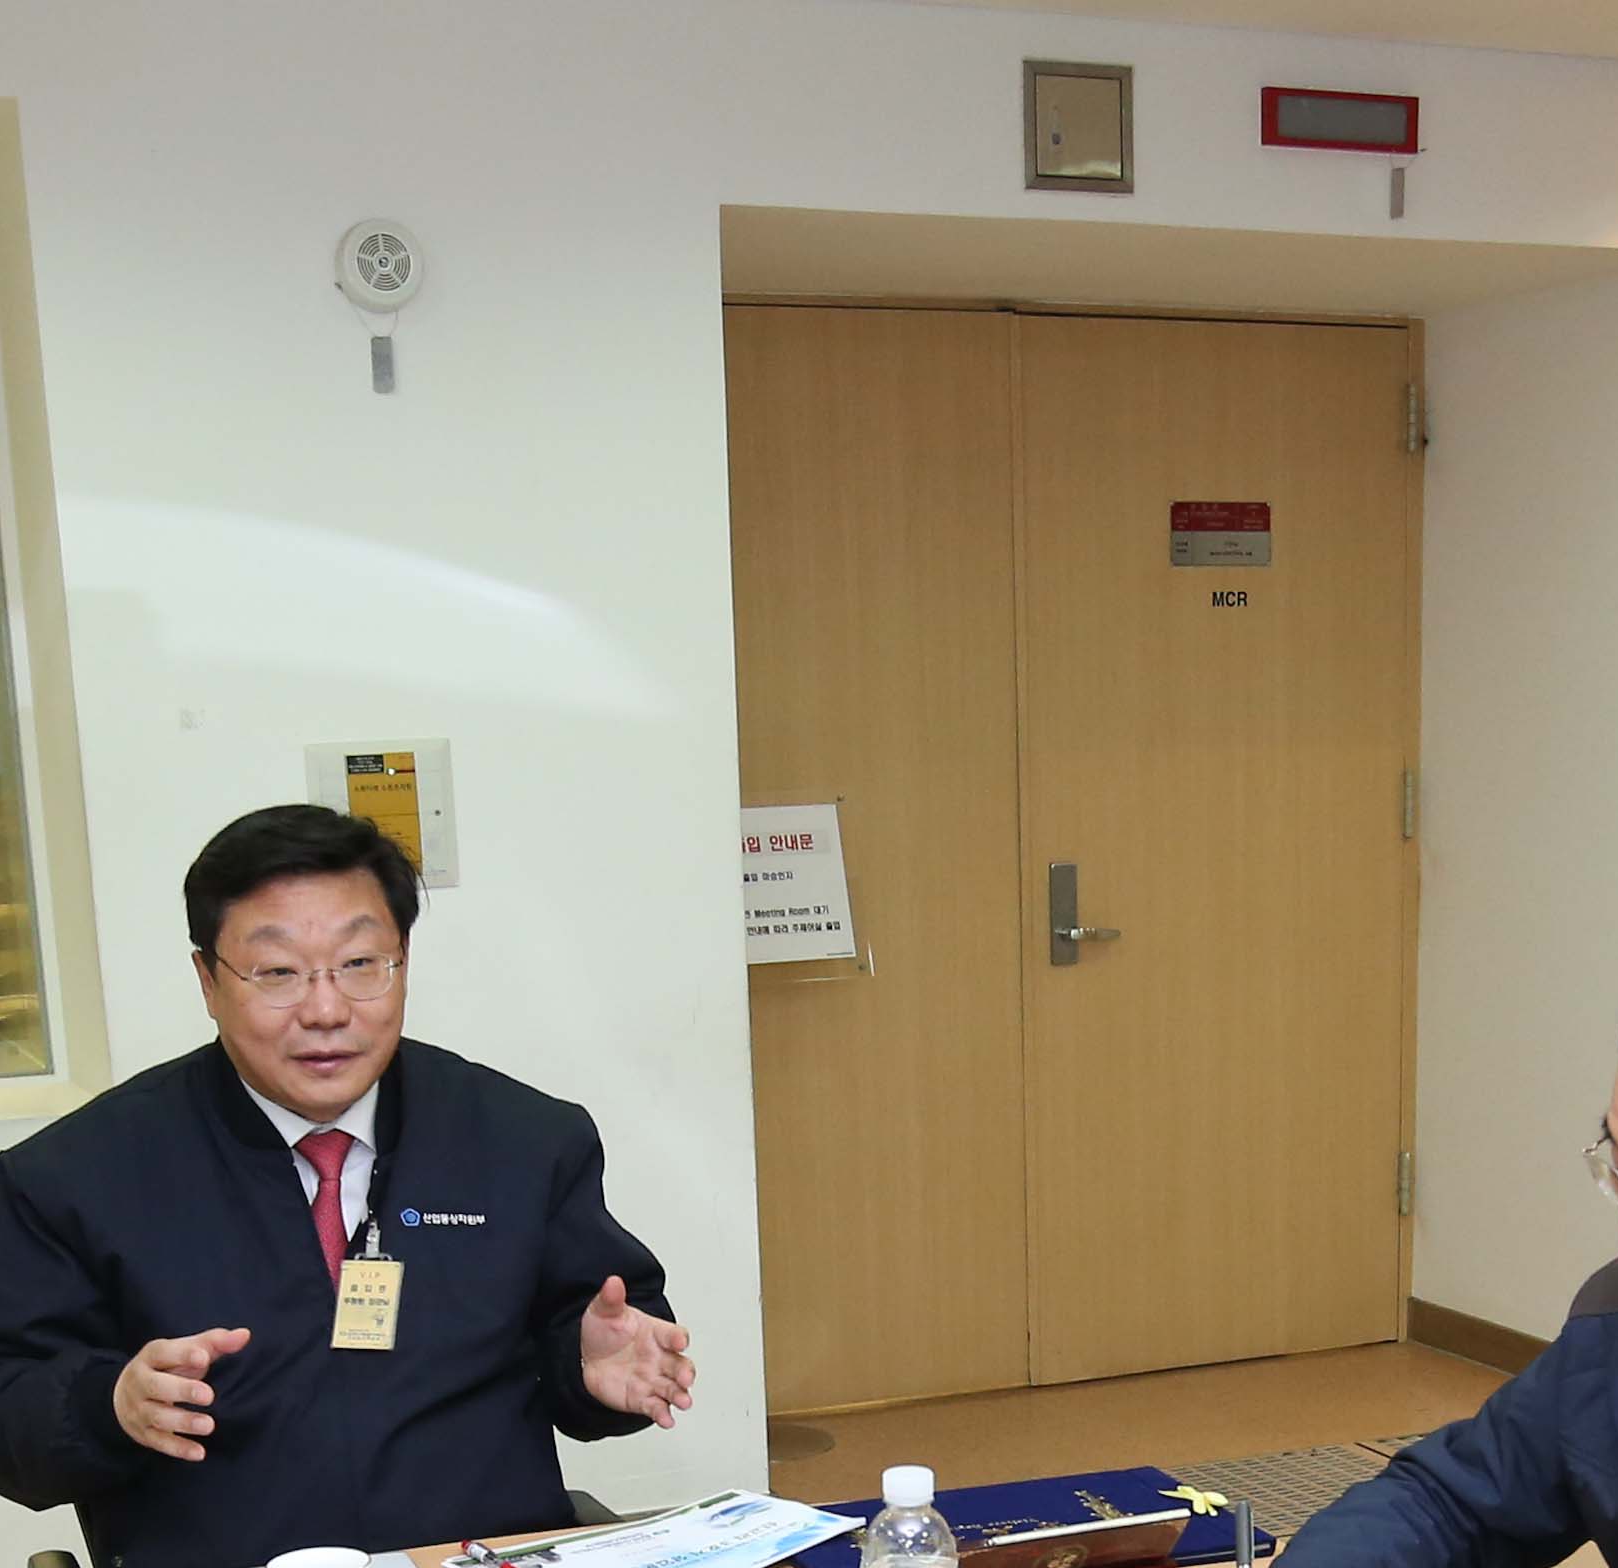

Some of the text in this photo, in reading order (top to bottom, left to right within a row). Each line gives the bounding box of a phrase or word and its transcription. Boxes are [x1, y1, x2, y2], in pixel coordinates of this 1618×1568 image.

[1211, 591, 1248, 607] MCR
[742, 833, 814, 853] 입 안내문
[754, 908, 786, 919] Meeting
[788, 906, 810, 916] Room
